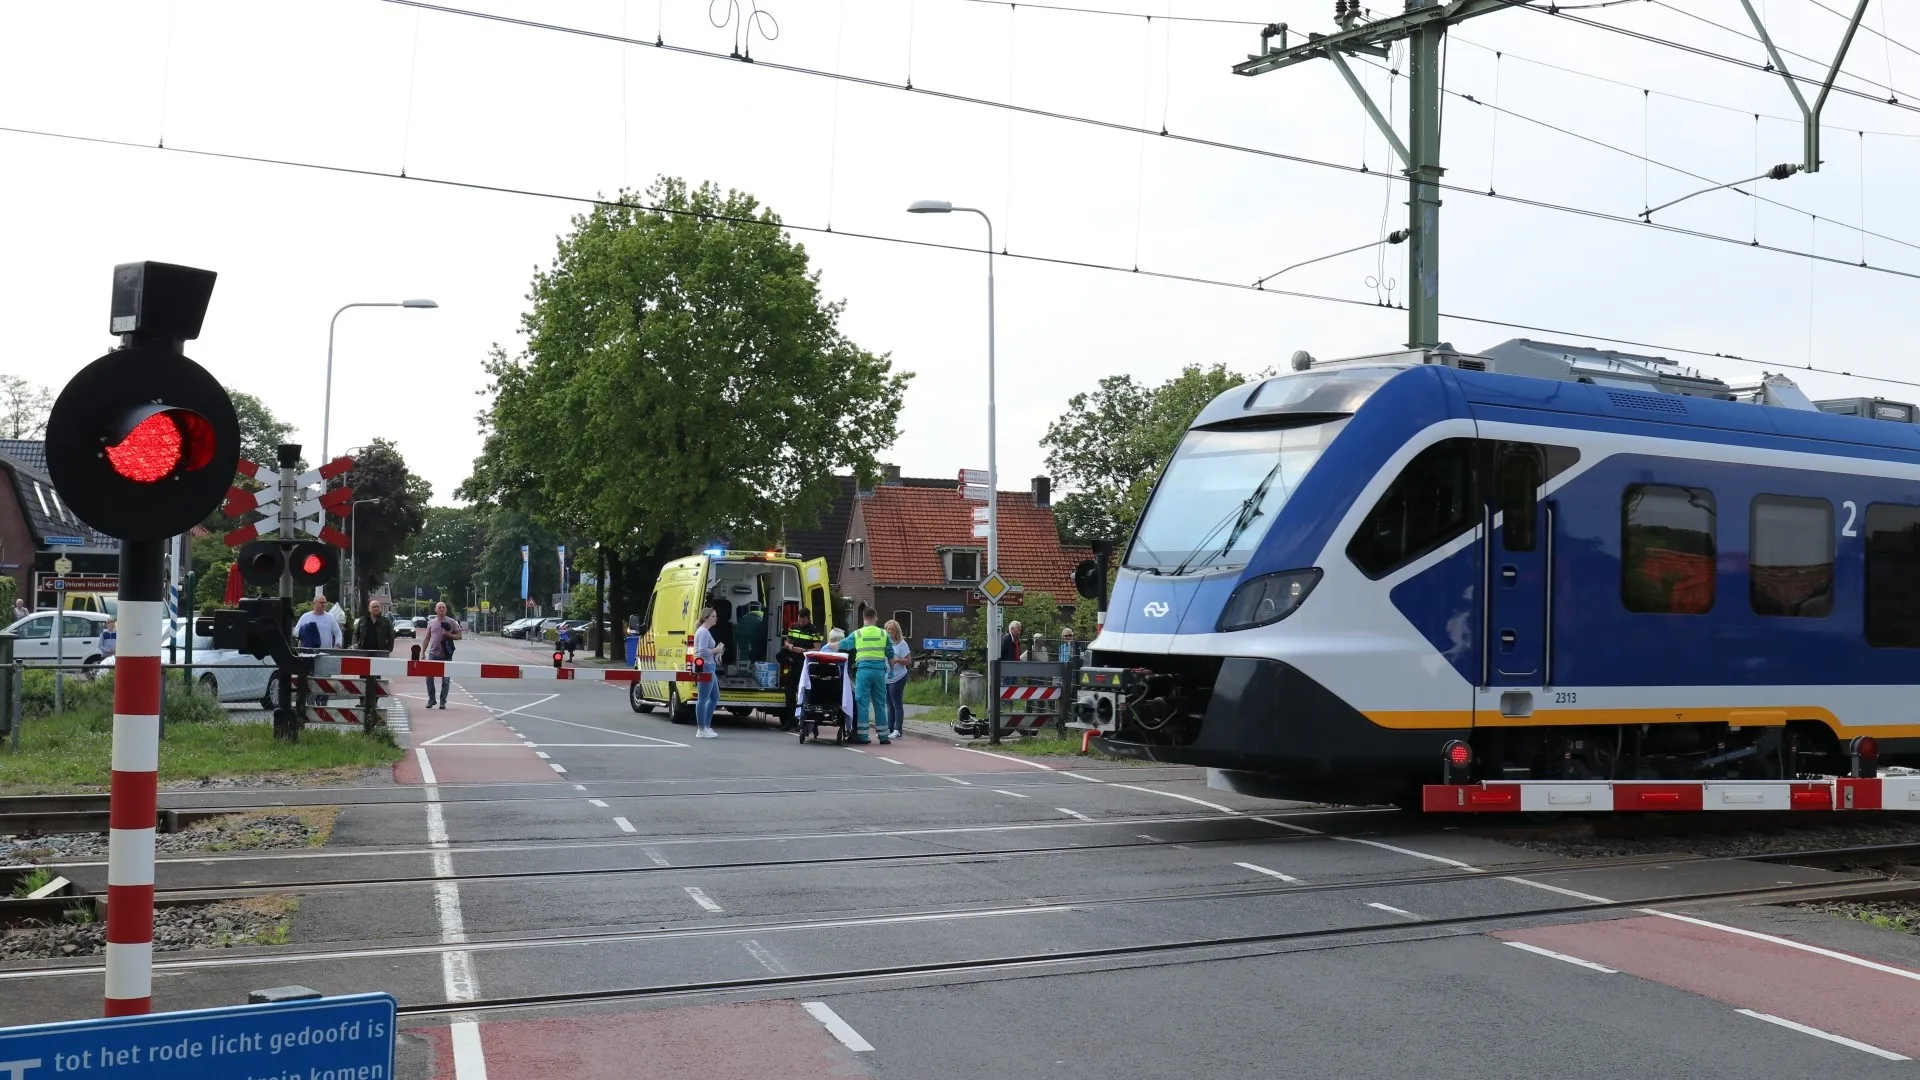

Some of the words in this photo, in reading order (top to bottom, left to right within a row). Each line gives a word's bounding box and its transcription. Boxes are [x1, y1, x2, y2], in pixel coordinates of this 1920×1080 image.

[1842, 500, 1857, 537] 2
[1555, 692, 1577, 704] 2313
[54, 1050, 92, 1072] tot
[100, 1045, 141, 1068] het
[149, 1038, 203, 1062] rode
[211, 1032, 263, 1056] licht
[269, 1020, 361, 1055] gedoofd
[367, 1018, 385, 1039] is
[310, 1064, 383, 1080] komen
